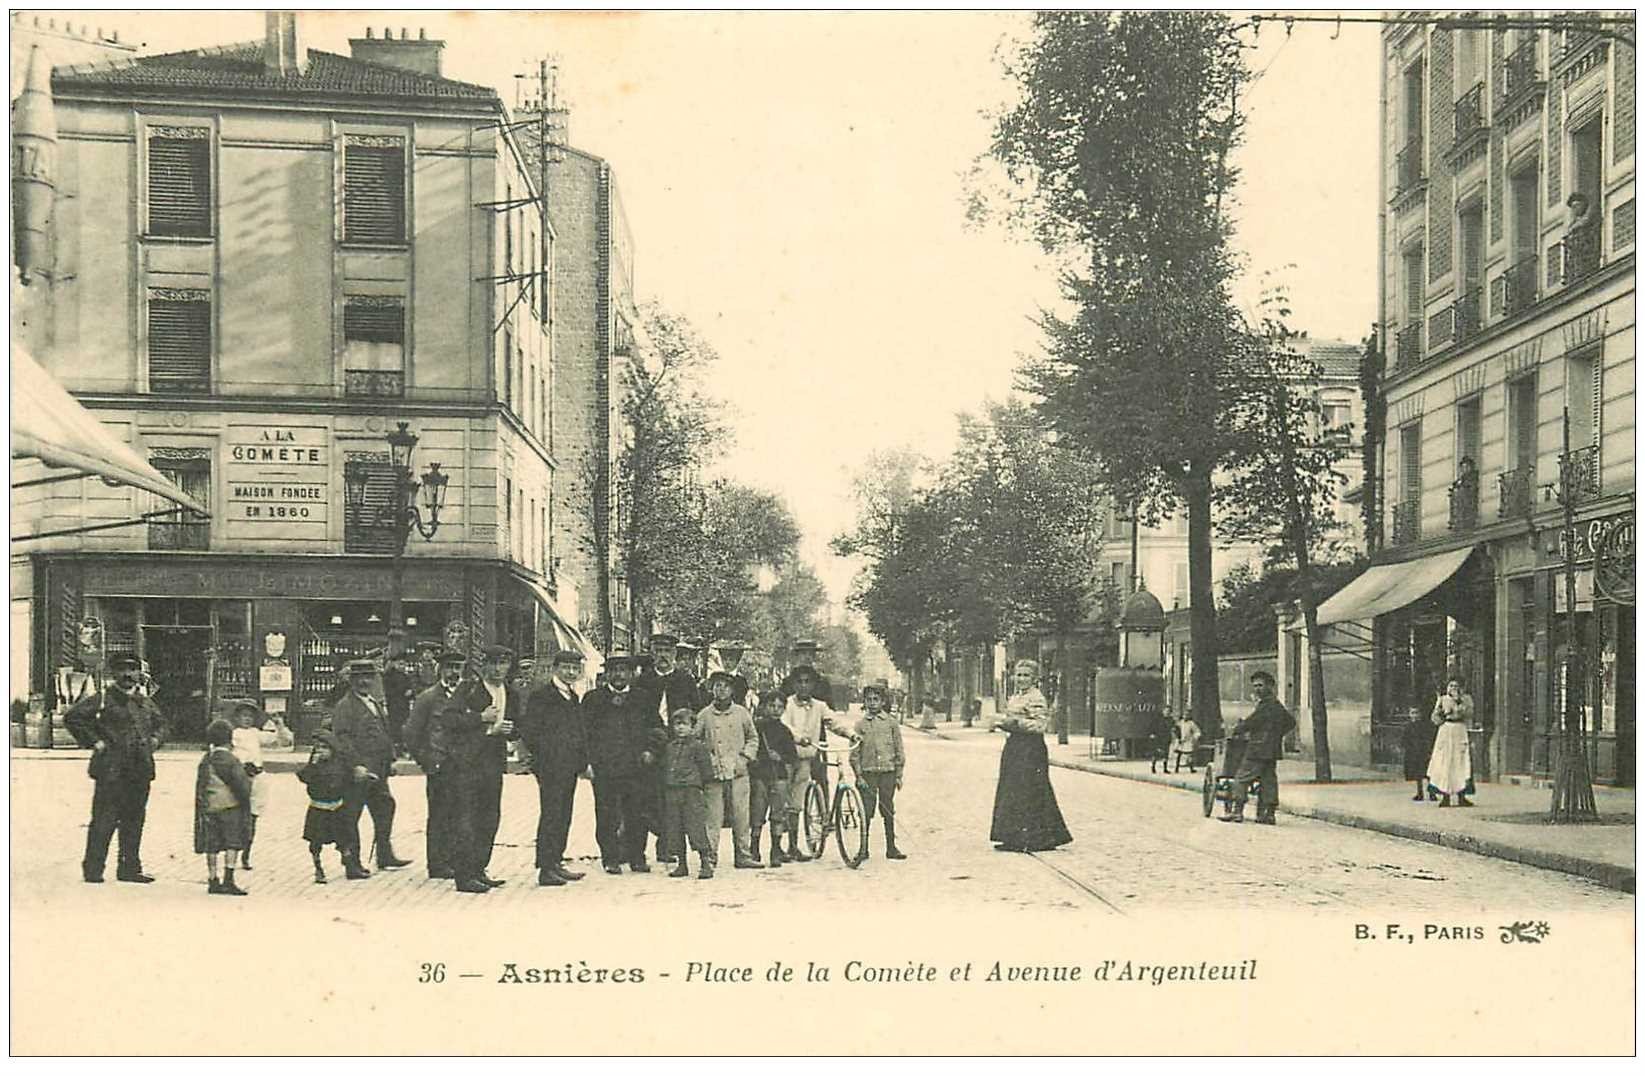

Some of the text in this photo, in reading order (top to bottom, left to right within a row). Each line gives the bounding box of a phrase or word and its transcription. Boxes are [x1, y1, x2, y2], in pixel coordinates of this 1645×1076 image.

[275, 430, 296, 442] LA
[235, 486, 274, 498] MAISON
[246, 506, 309, 518] EN 1860
